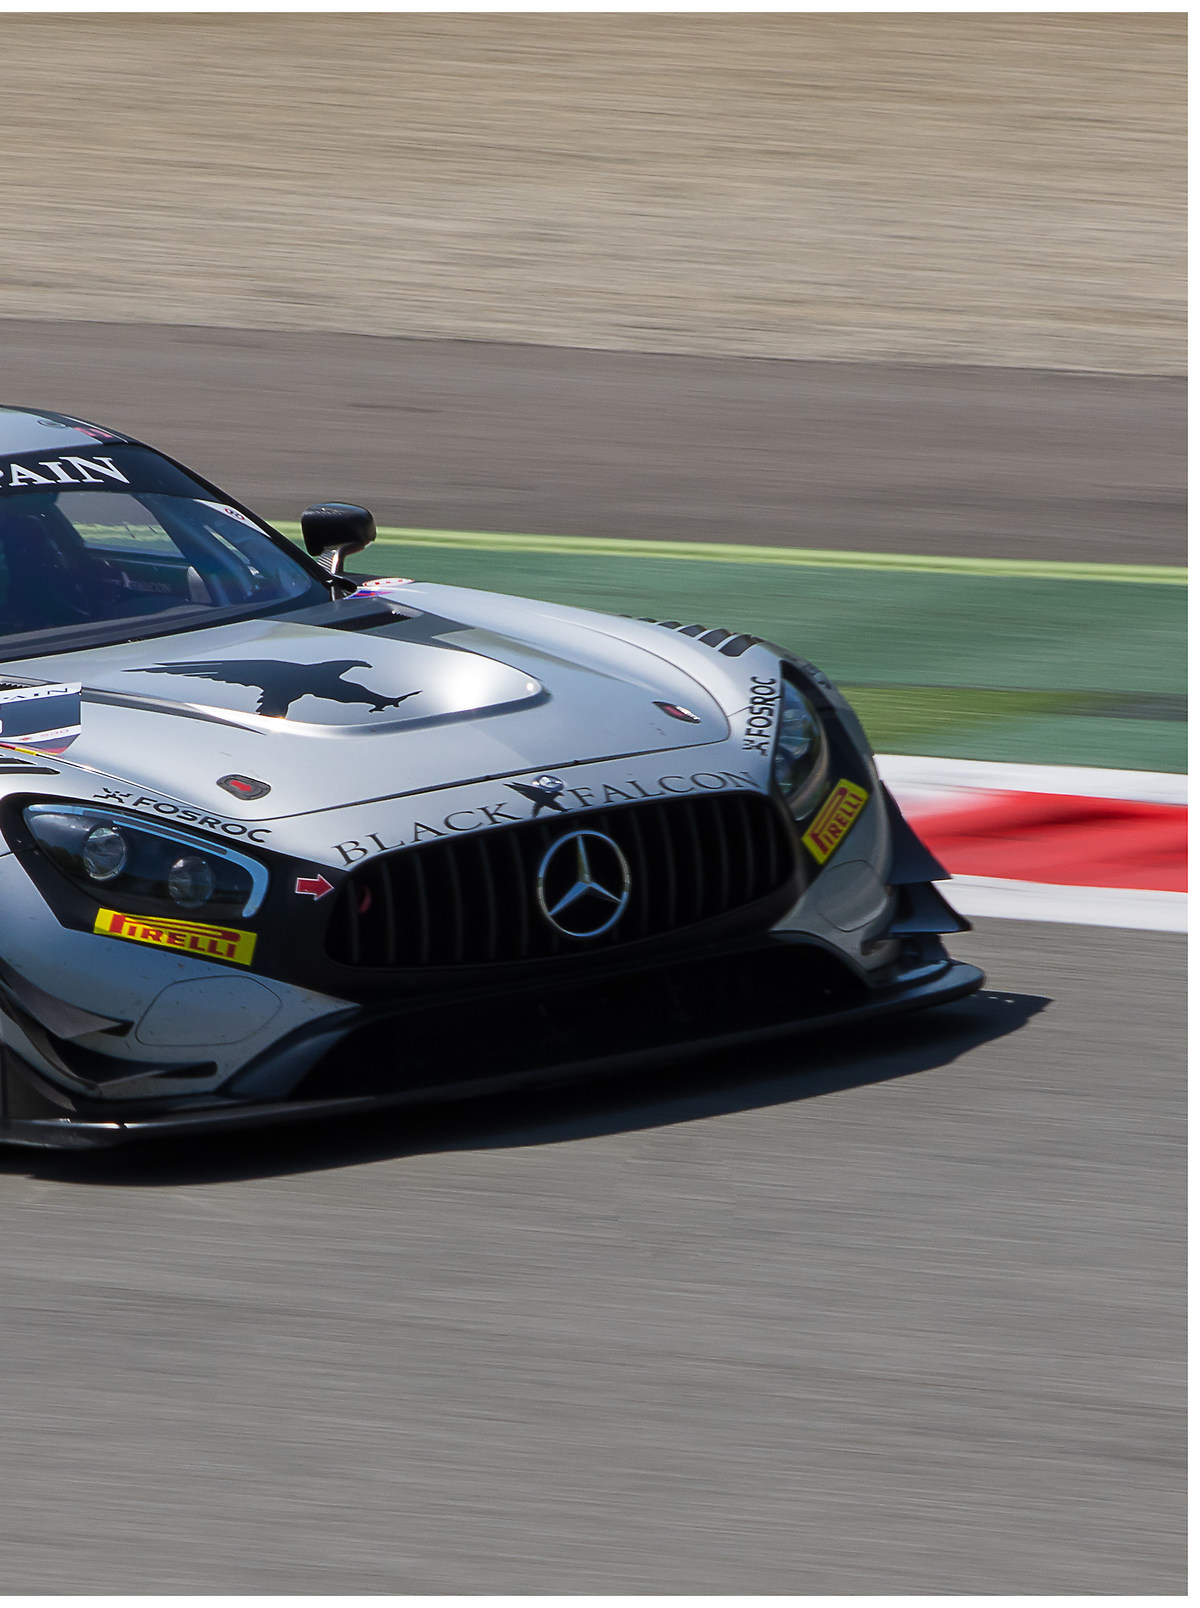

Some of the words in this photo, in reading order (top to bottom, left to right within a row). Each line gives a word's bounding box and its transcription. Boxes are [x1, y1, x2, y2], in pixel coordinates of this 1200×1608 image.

[749, 676, 781, 739] FOSROC
[132, 797, 272, 843] FOSROC
[331, 802, 521, 865] BLACK
[568, 771, 759, 812] FALCON
[808, 786, 864, 856] PIRELLI
[110, 914, 241, 959] PIRELLI
